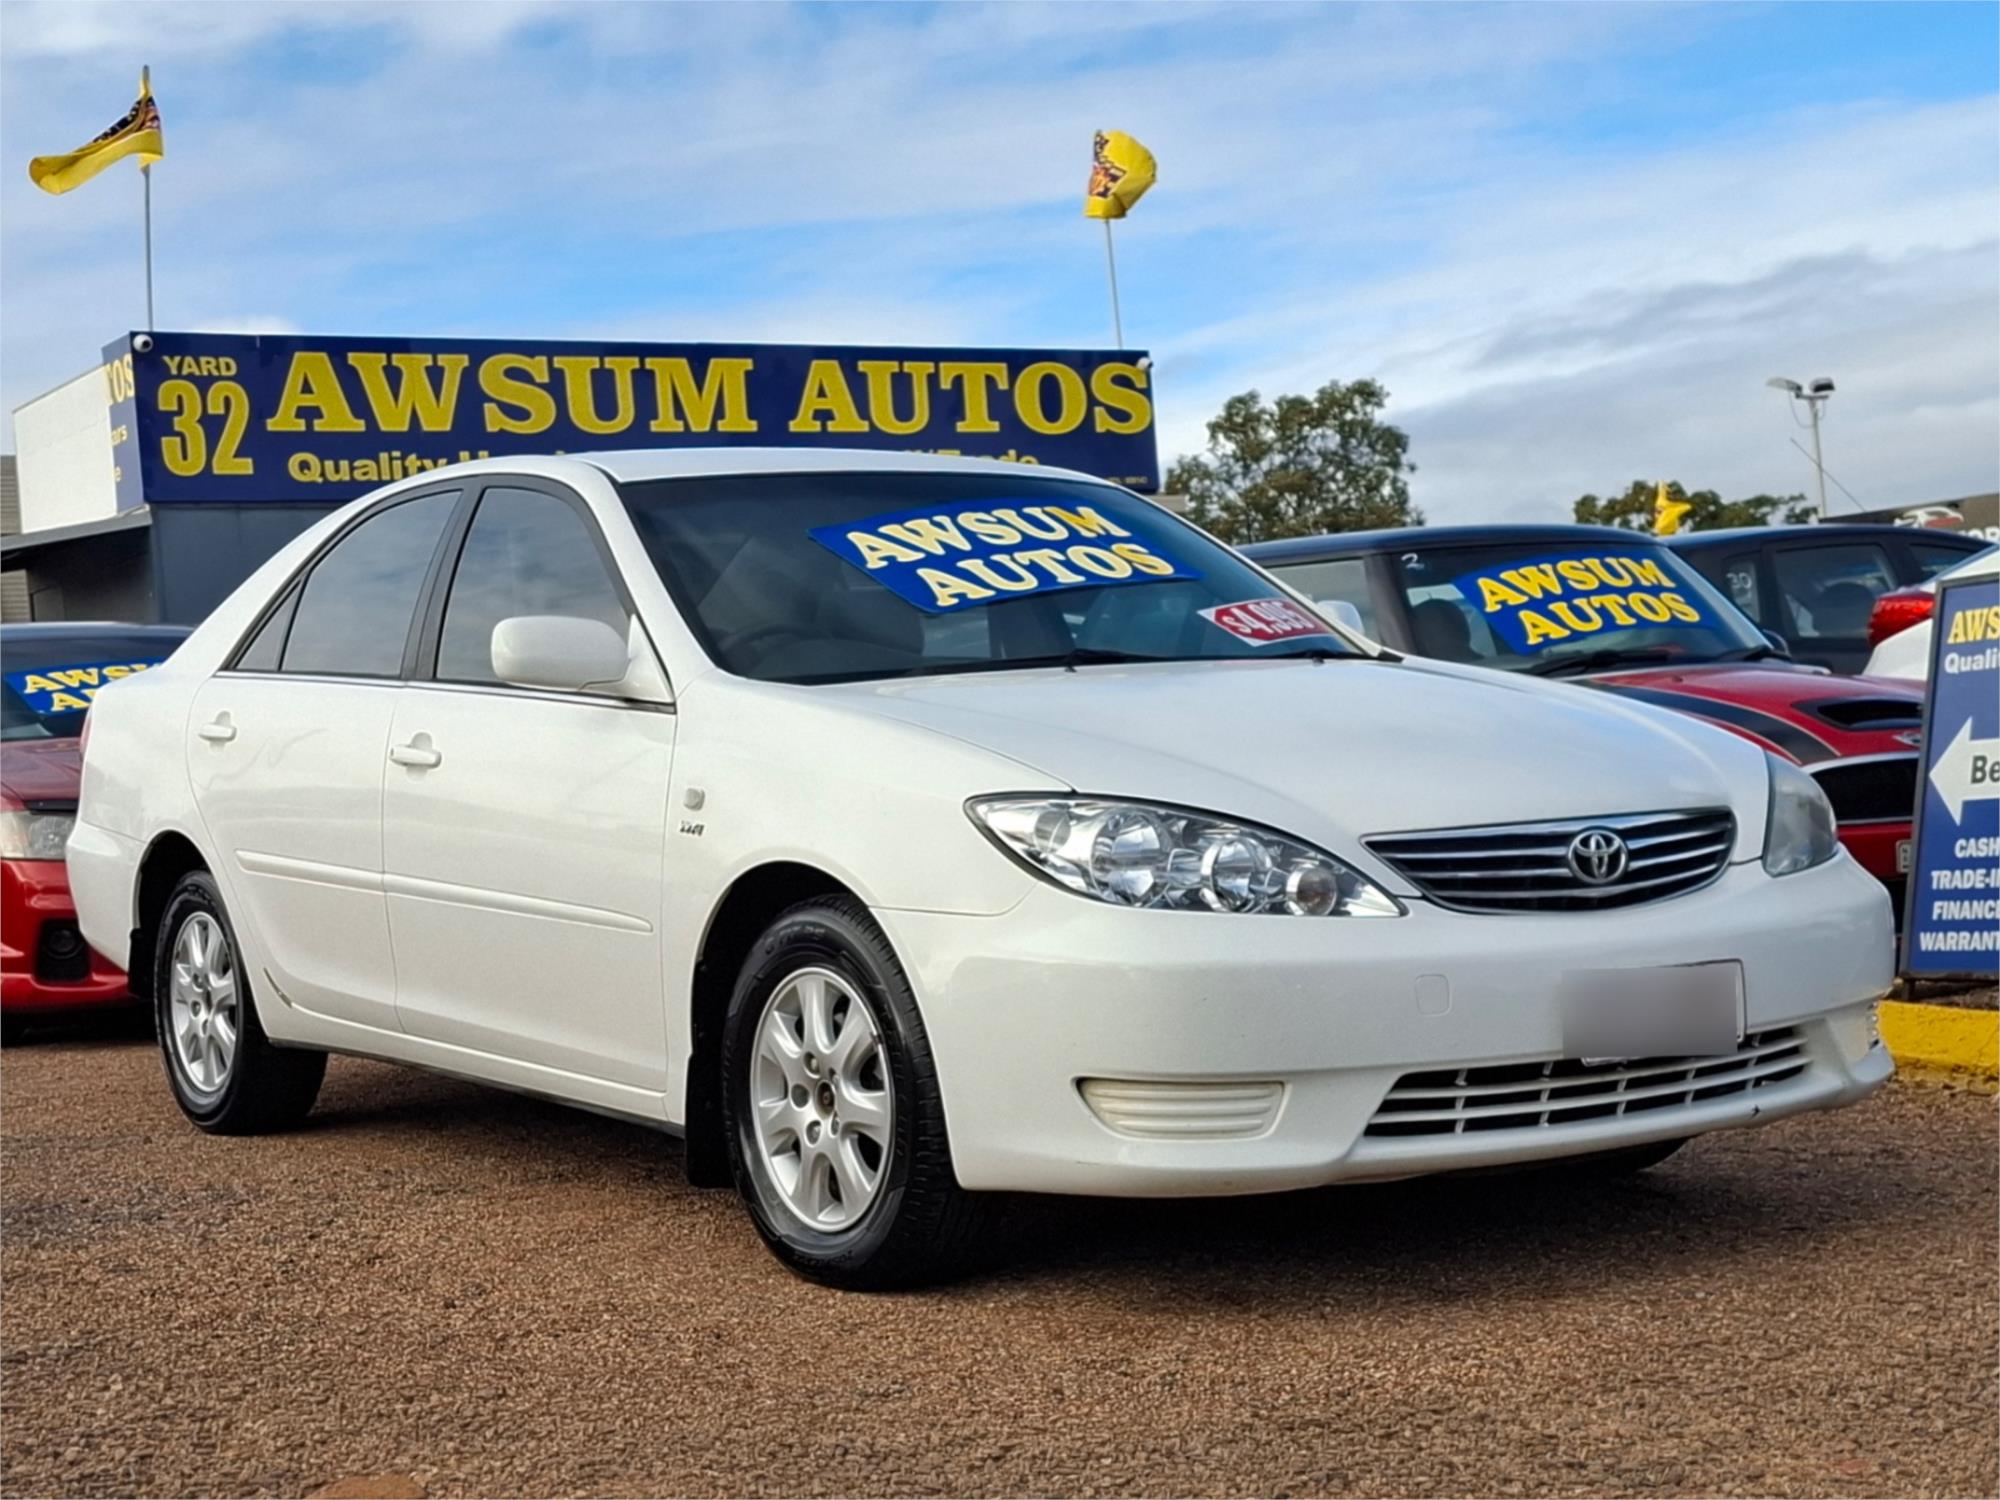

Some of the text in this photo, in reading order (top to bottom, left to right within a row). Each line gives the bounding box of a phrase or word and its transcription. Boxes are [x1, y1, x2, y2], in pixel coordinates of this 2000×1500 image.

[162, 355, 237, 376] YARD
[266, 351, 1153, 435] AWSUM AUTOS
[157, 379, 254, 477] 32
[846, 506, 1132, 570] AWSUM
[916, 543, 1175, 607] AUTOS
[1477, 556, 1676, 613] AWSUM
[1518, 592, 1701, 645] AUTOS
[1944, 647, 2000, 675] Quali
[1954, 837, 2000, 859] CASH
